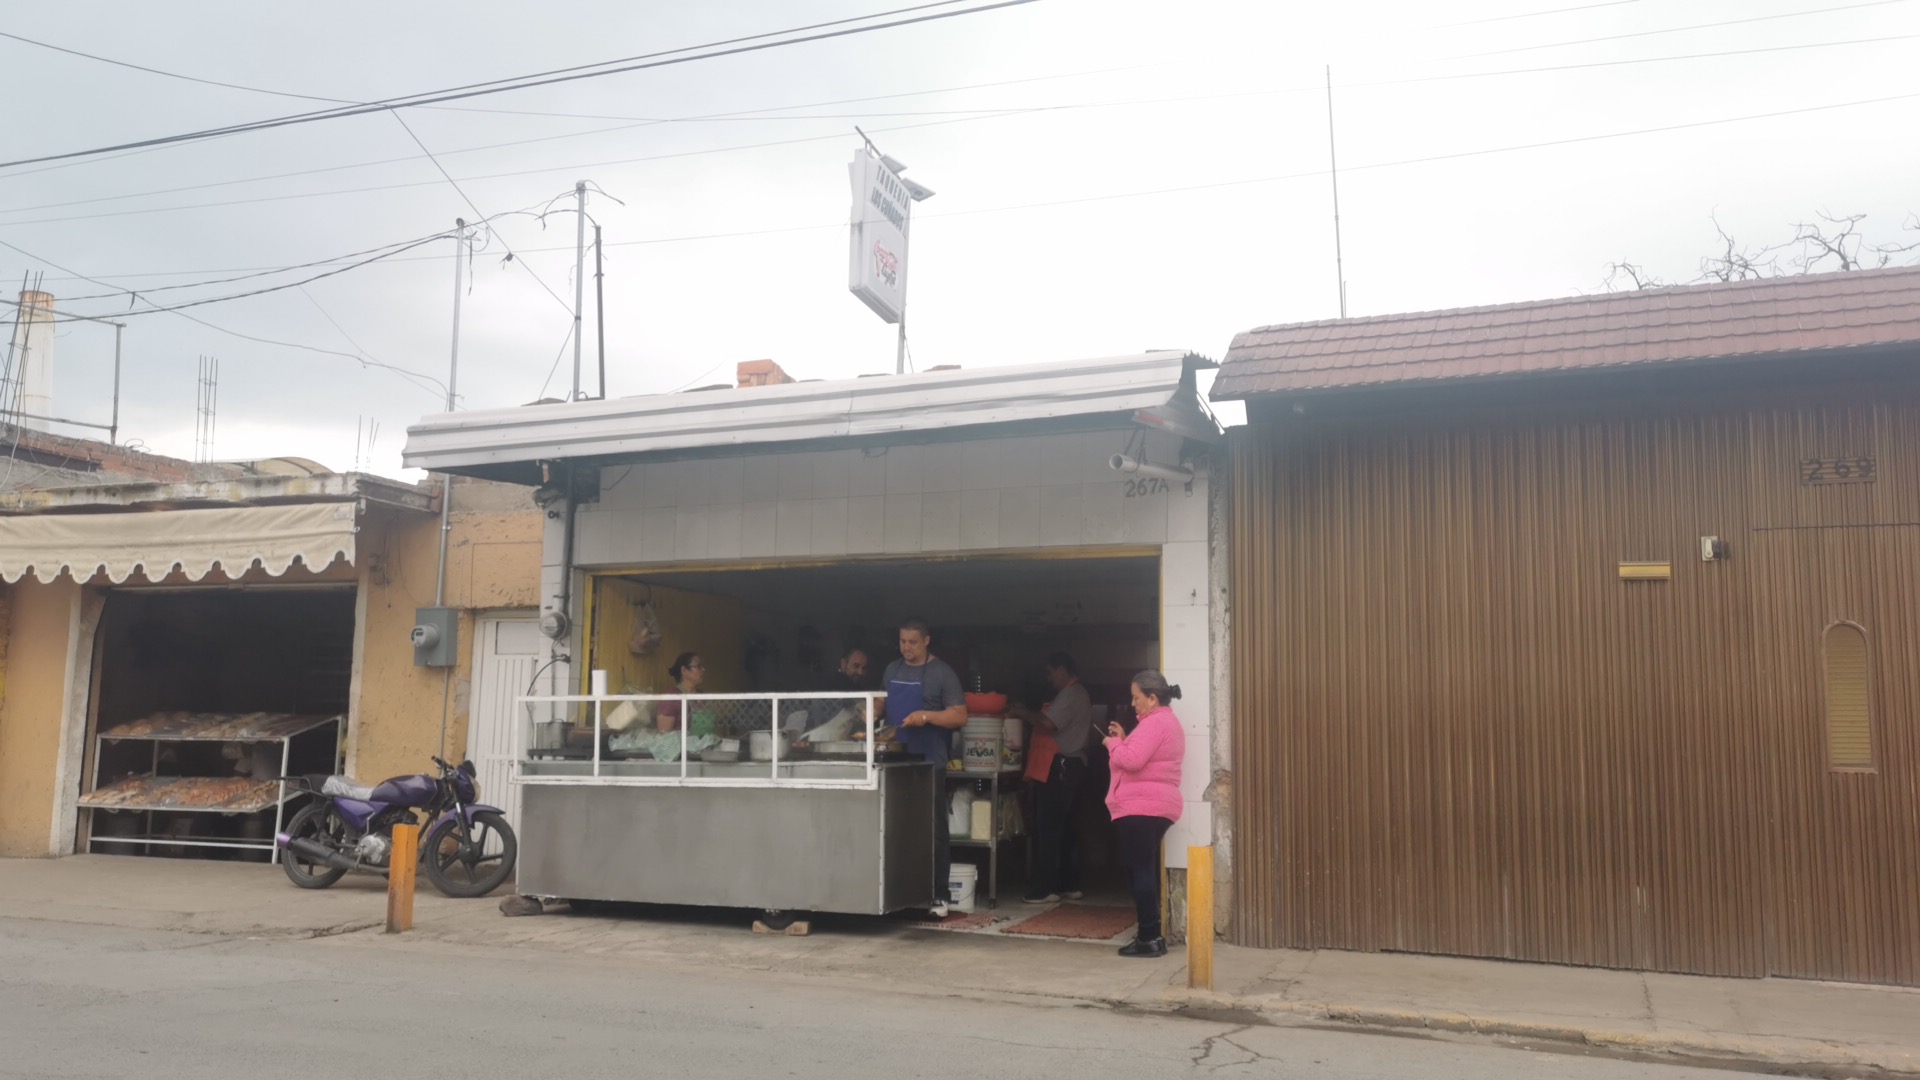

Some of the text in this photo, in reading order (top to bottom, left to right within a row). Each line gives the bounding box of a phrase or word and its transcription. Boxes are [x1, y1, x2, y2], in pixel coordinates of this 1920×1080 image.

[871, 186, 882, 208] LOS
[876, 164, 909, 211] TAQUERIA
[1809, 457, 1873, 482] 269
[1124, 477, 1169, 498] 267A
